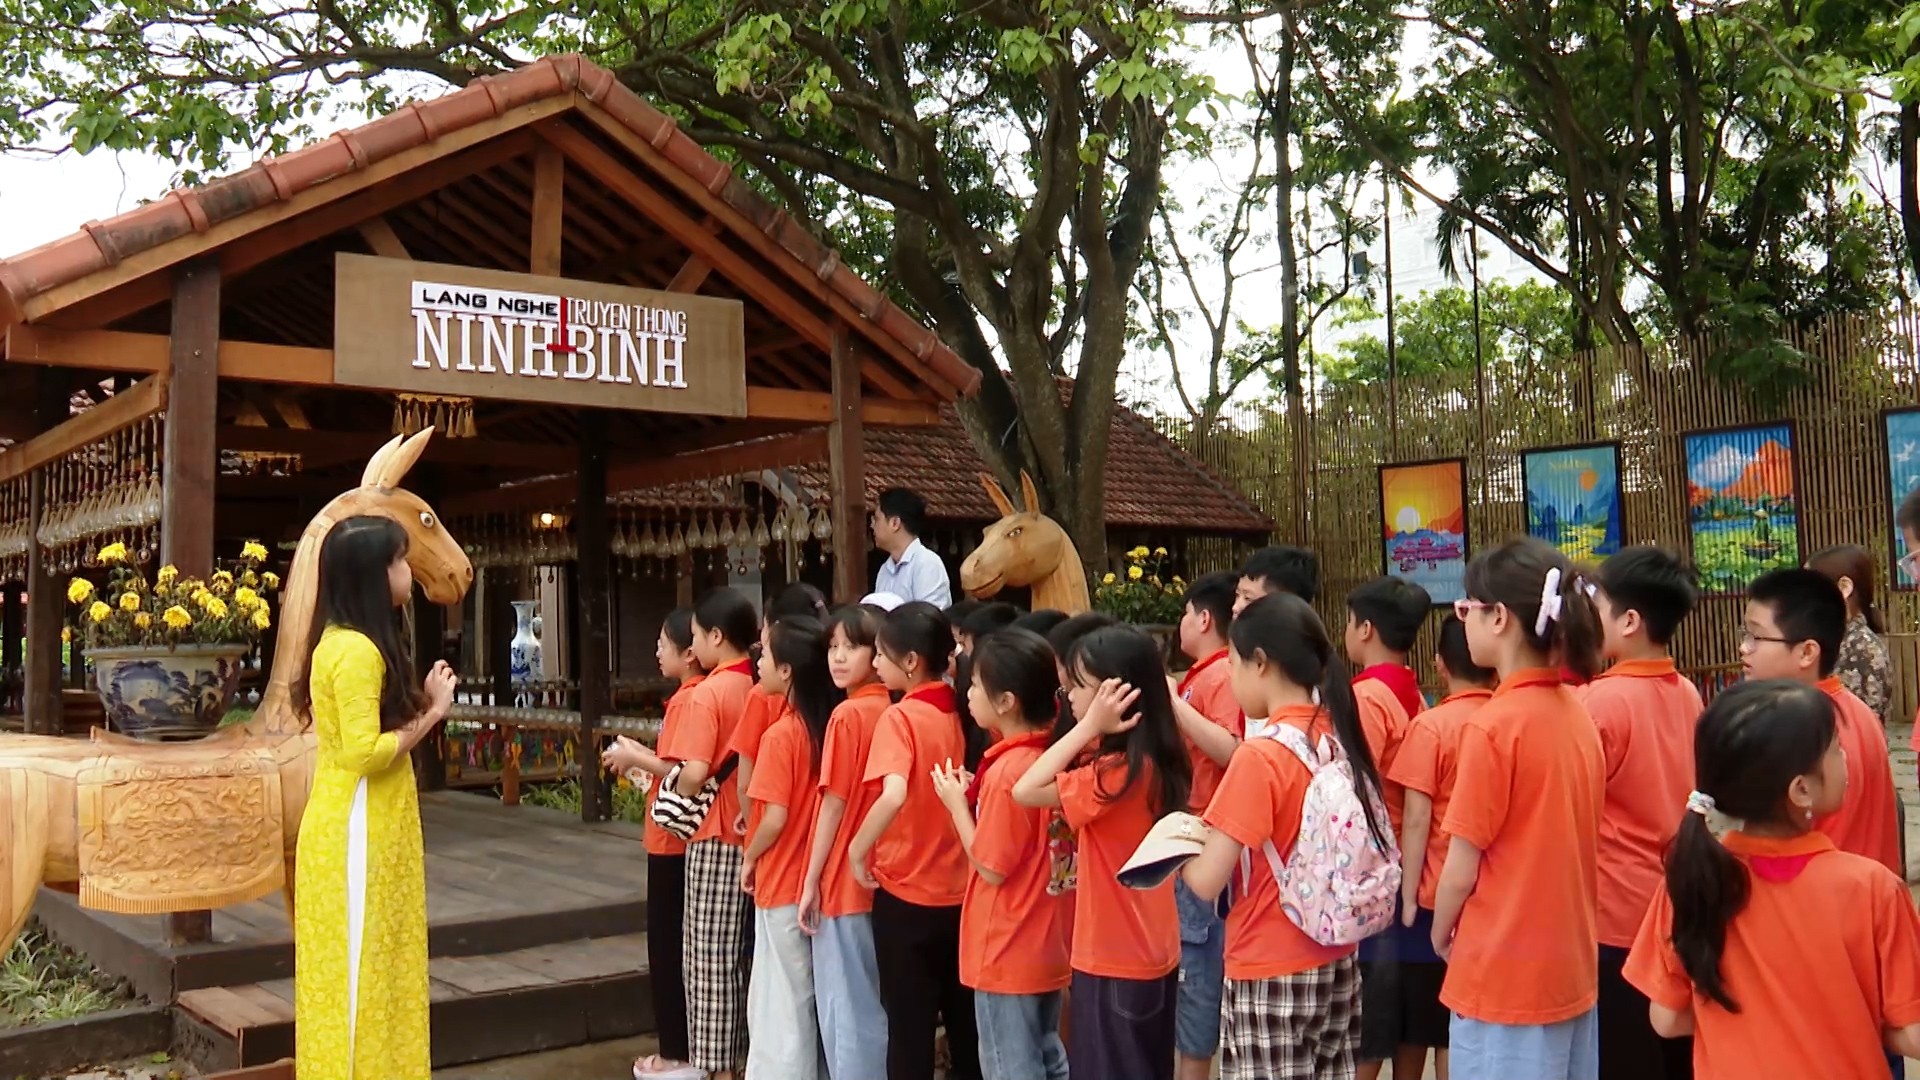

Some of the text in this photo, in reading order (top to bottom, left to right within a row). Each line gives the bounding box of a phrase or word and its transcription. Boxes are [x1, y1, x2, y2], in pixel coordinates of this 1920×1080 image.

[422, 288, 687, 336] LANG NGHE TRUYEN THONG
[411, 309, 688, 389] NINH BINH
